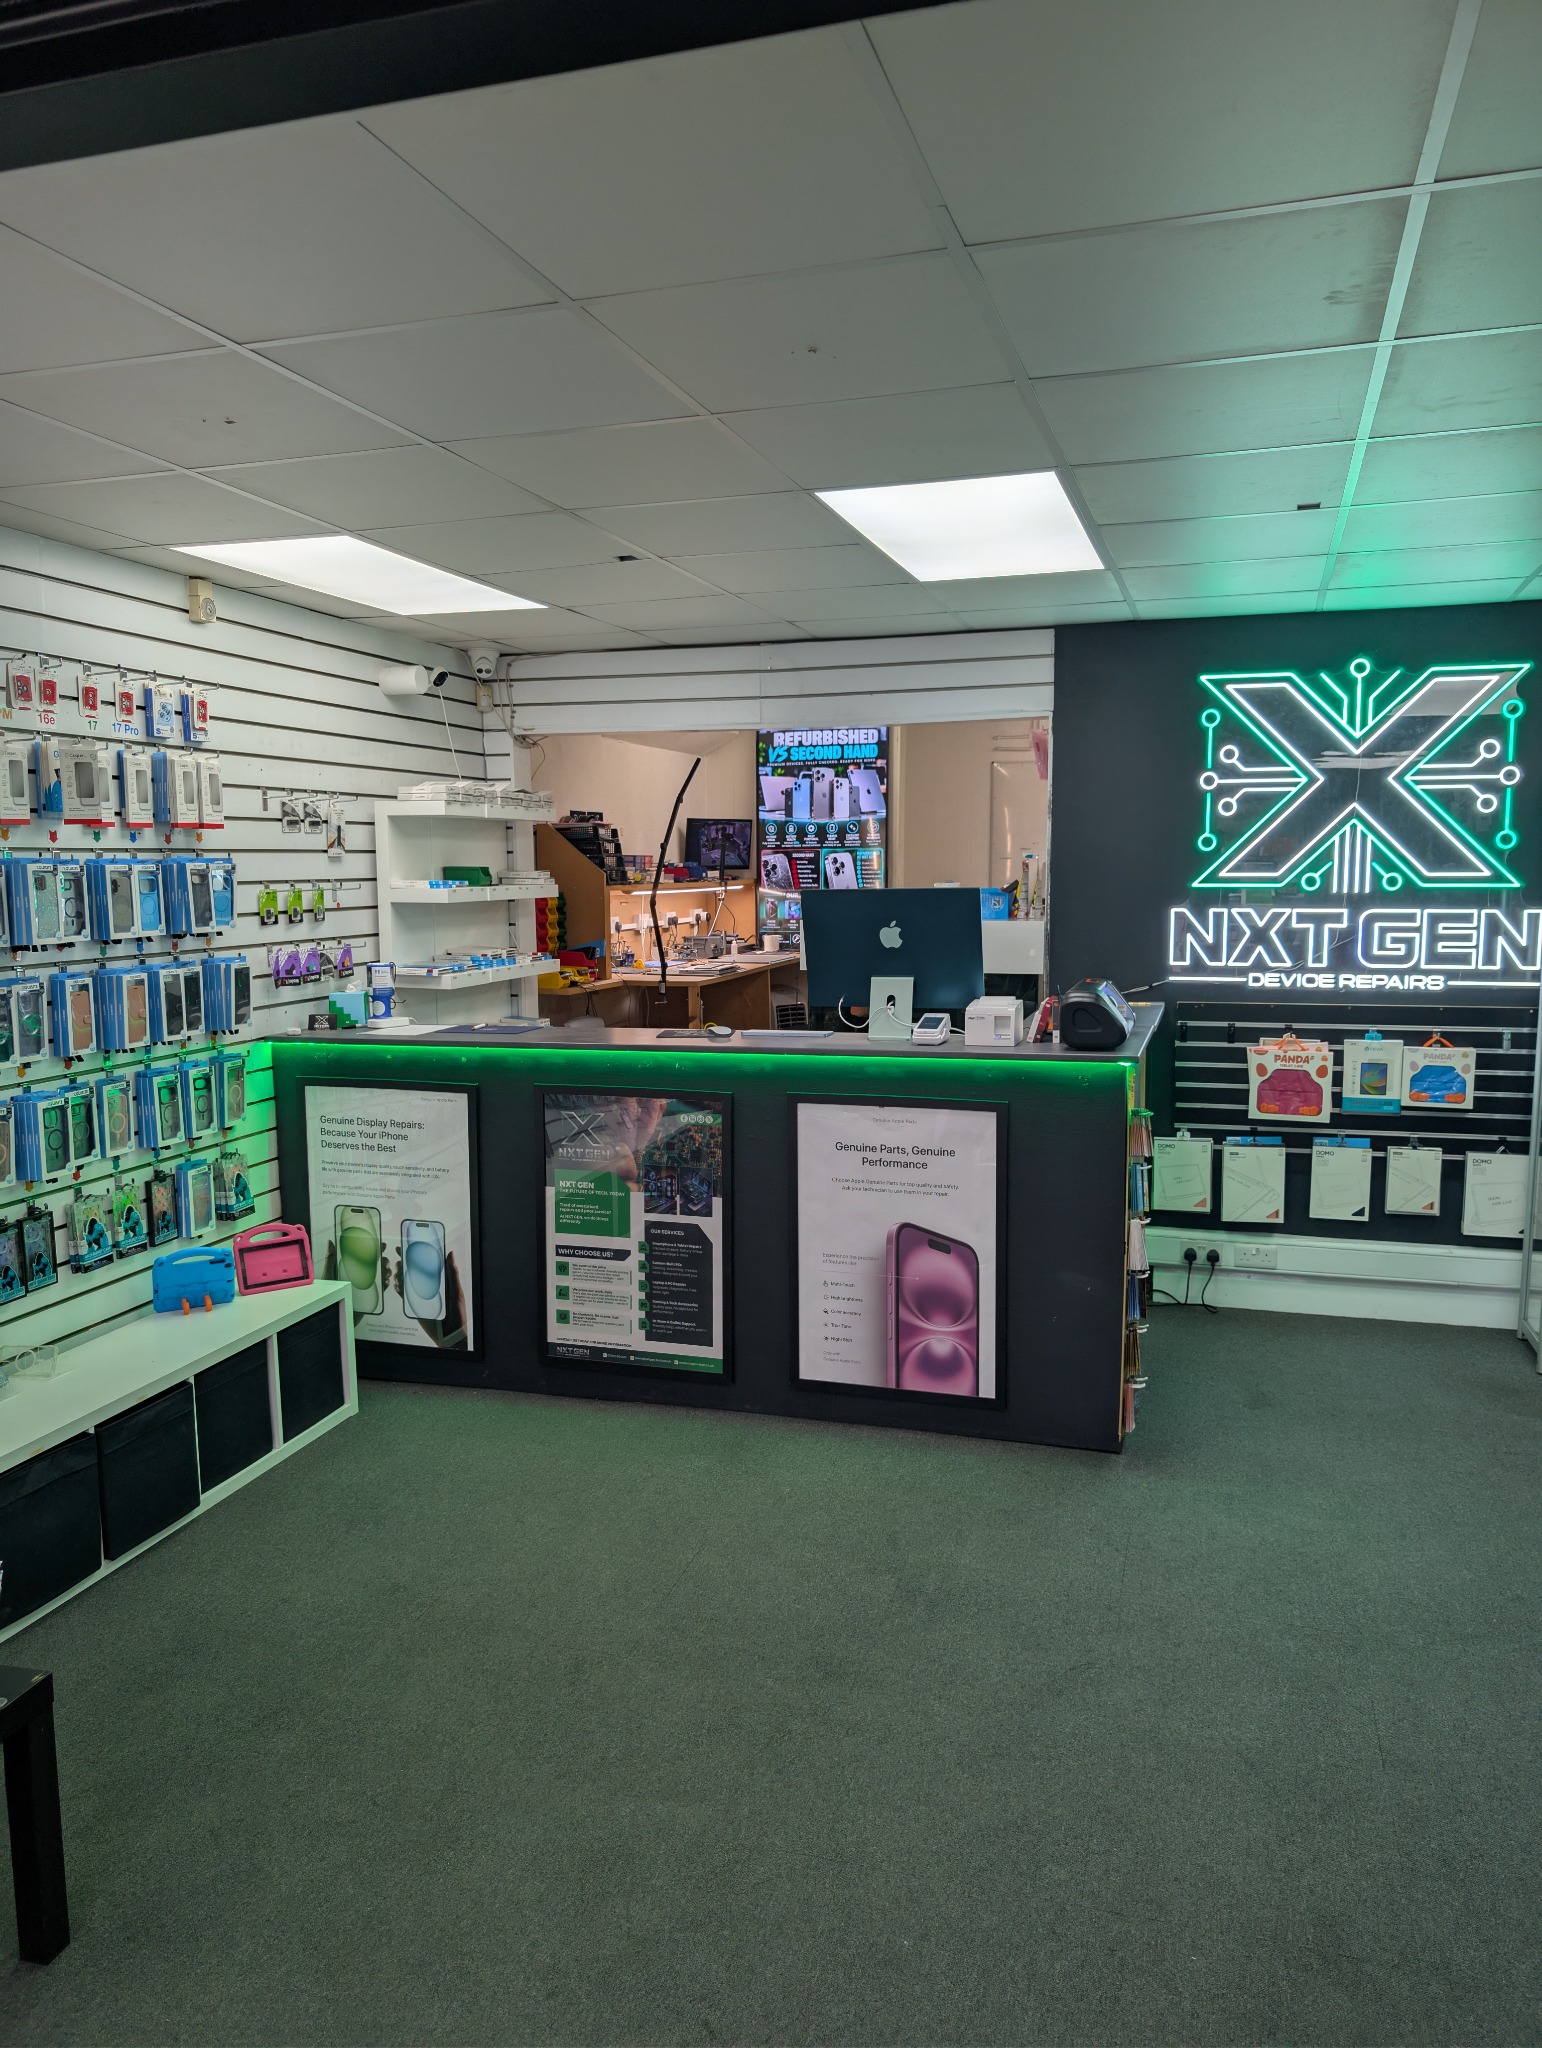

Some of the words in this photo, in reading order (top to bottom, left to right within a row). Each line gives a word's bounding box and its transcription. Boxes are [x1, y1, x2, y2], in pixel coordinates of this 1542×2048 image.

[37, 713, 56, 725] 16e
[87, 720, 98, 731] 17
[111, 722, 122, 733] 17
[124, 723, 139, 736] Pro
[773, 729, 879, 747] REFURBISHED
[768, 744, 790, 763] VS
[790, 745, 842, 761] SECOND
[843, 744, 879, 759] HAND
[1168, 907, 1348, 967] NXT
[1356, 908, 1542, 971] GEN
[1247, 971, 1336, 990] DEVICE
[1338, 973, 1445, 991] REPAIRS
[320, 1115, 355, 1125] Genuine
[356, 1117, 388, 1129] Display
[390, 1119, 425, 1130] Repairs:
[320, 1127, 356, 1138] Because
[358, 1129, 377, 1139] Your
[379, 1131, 409, 1141] iPhone
[321, 1139, 360, 1150] Deserves
[361, 1142, 375, 1151] the
[377, 1143, 397, 1152] Best
[835, 1141, 877, 1153] Genuine
[880, 1144, 909, 1156] Parts,
[911, 1146, 956, 1157] Genuine
[558, 1147, 583, 1157] NXT
[585, 1149, 610, 1159] GEN
[862, 1157, 928, 1169] Performance
[574, 1249, 601, 1257] CHOOSE
[556, 1346, 573, 1354] NXT
[574, 1348, 590, 1356] GEN
